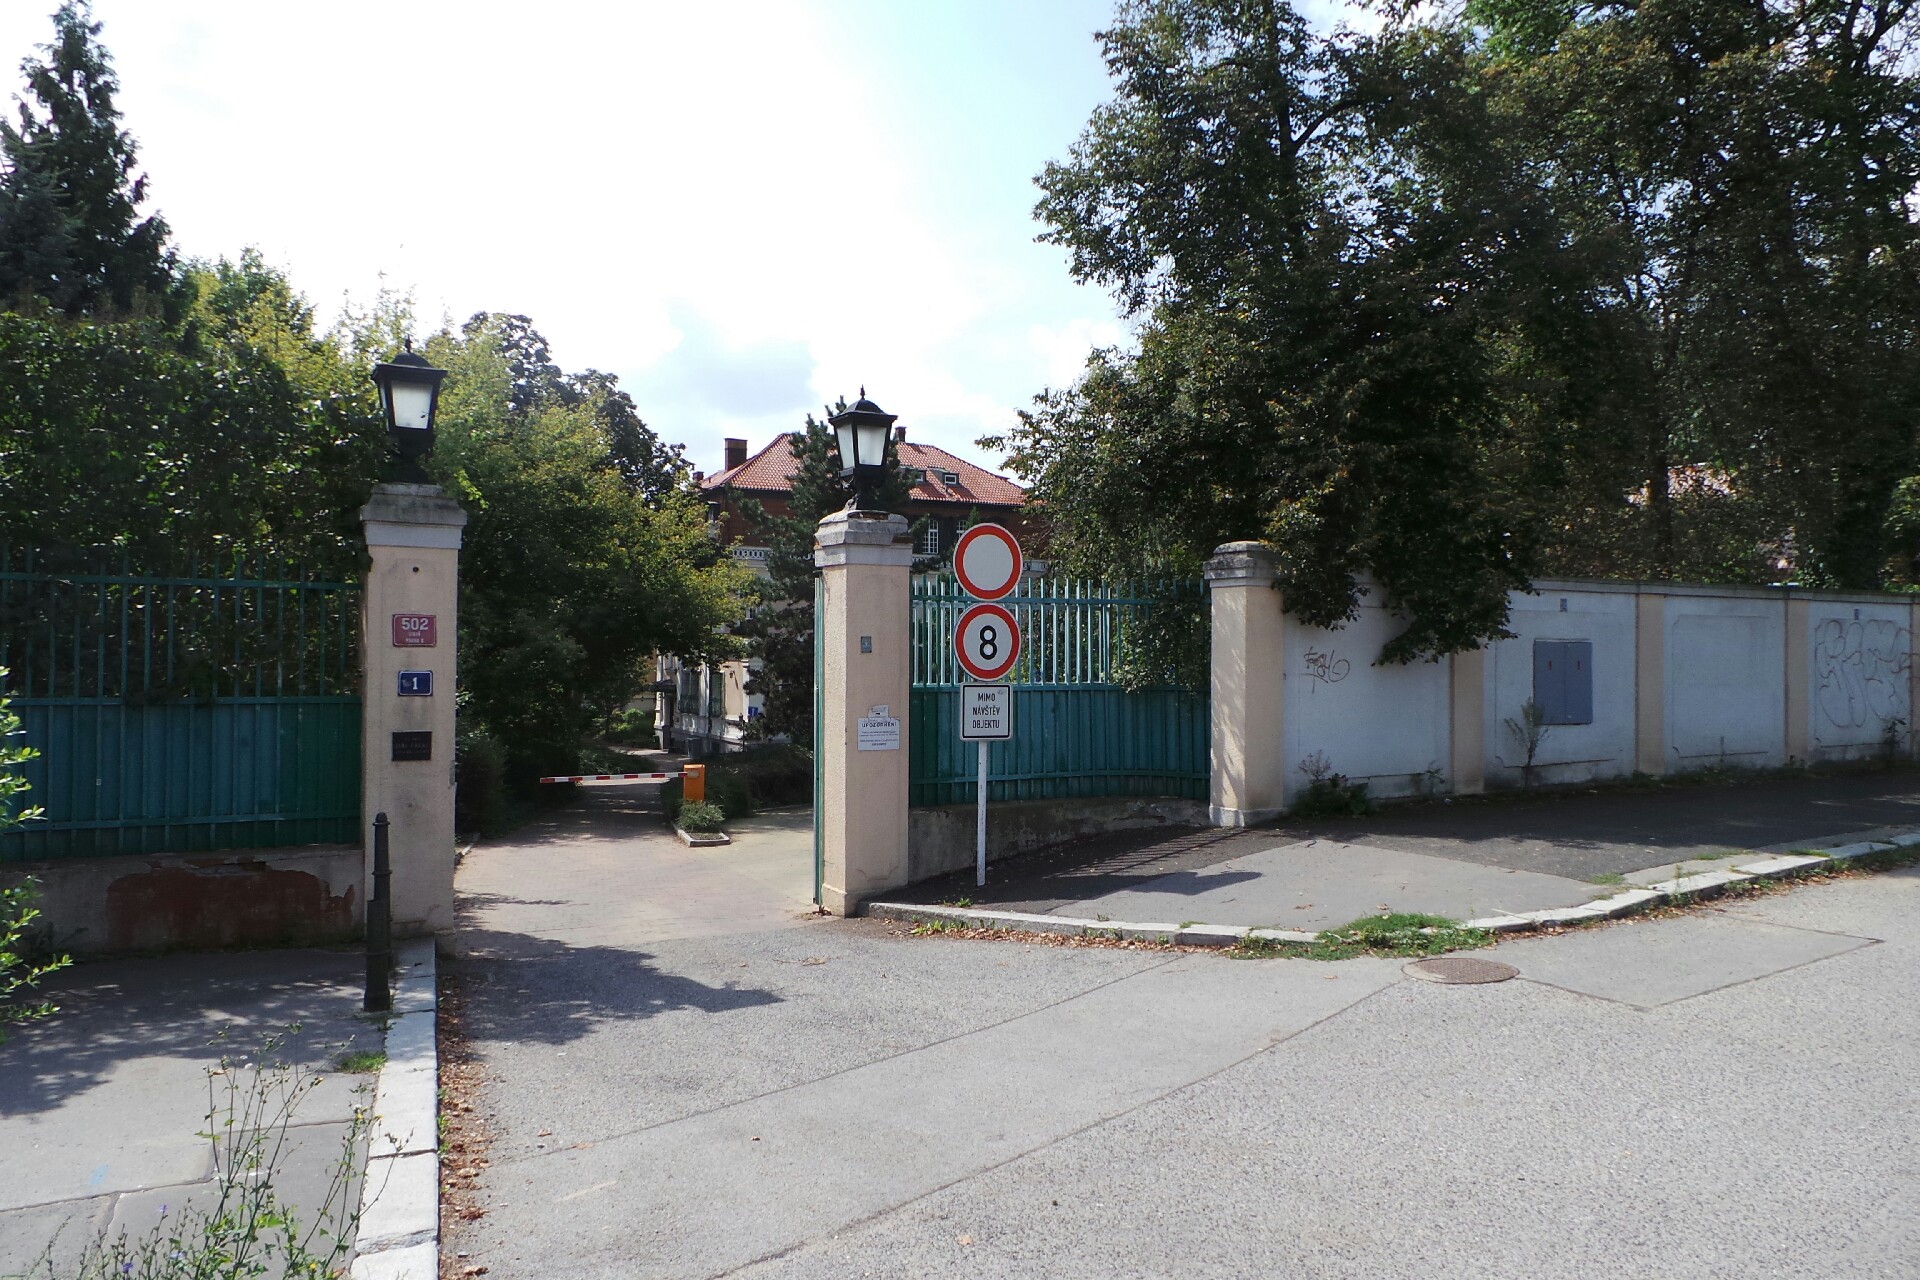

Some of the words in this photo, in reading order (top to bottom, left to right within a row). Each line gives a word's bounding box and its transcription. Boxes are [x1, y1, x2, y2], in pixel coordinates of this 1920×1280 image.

[401, 617, 429, 630] 502
[979, 625, 998, 660] 8
[412, 676, 418, 690] 1
[977, 692, 996, 702] MIMO
[972, 704, 1000, 716] NÁVŠTĚV
[972, 719, 1000, 729] OBJEKTU
